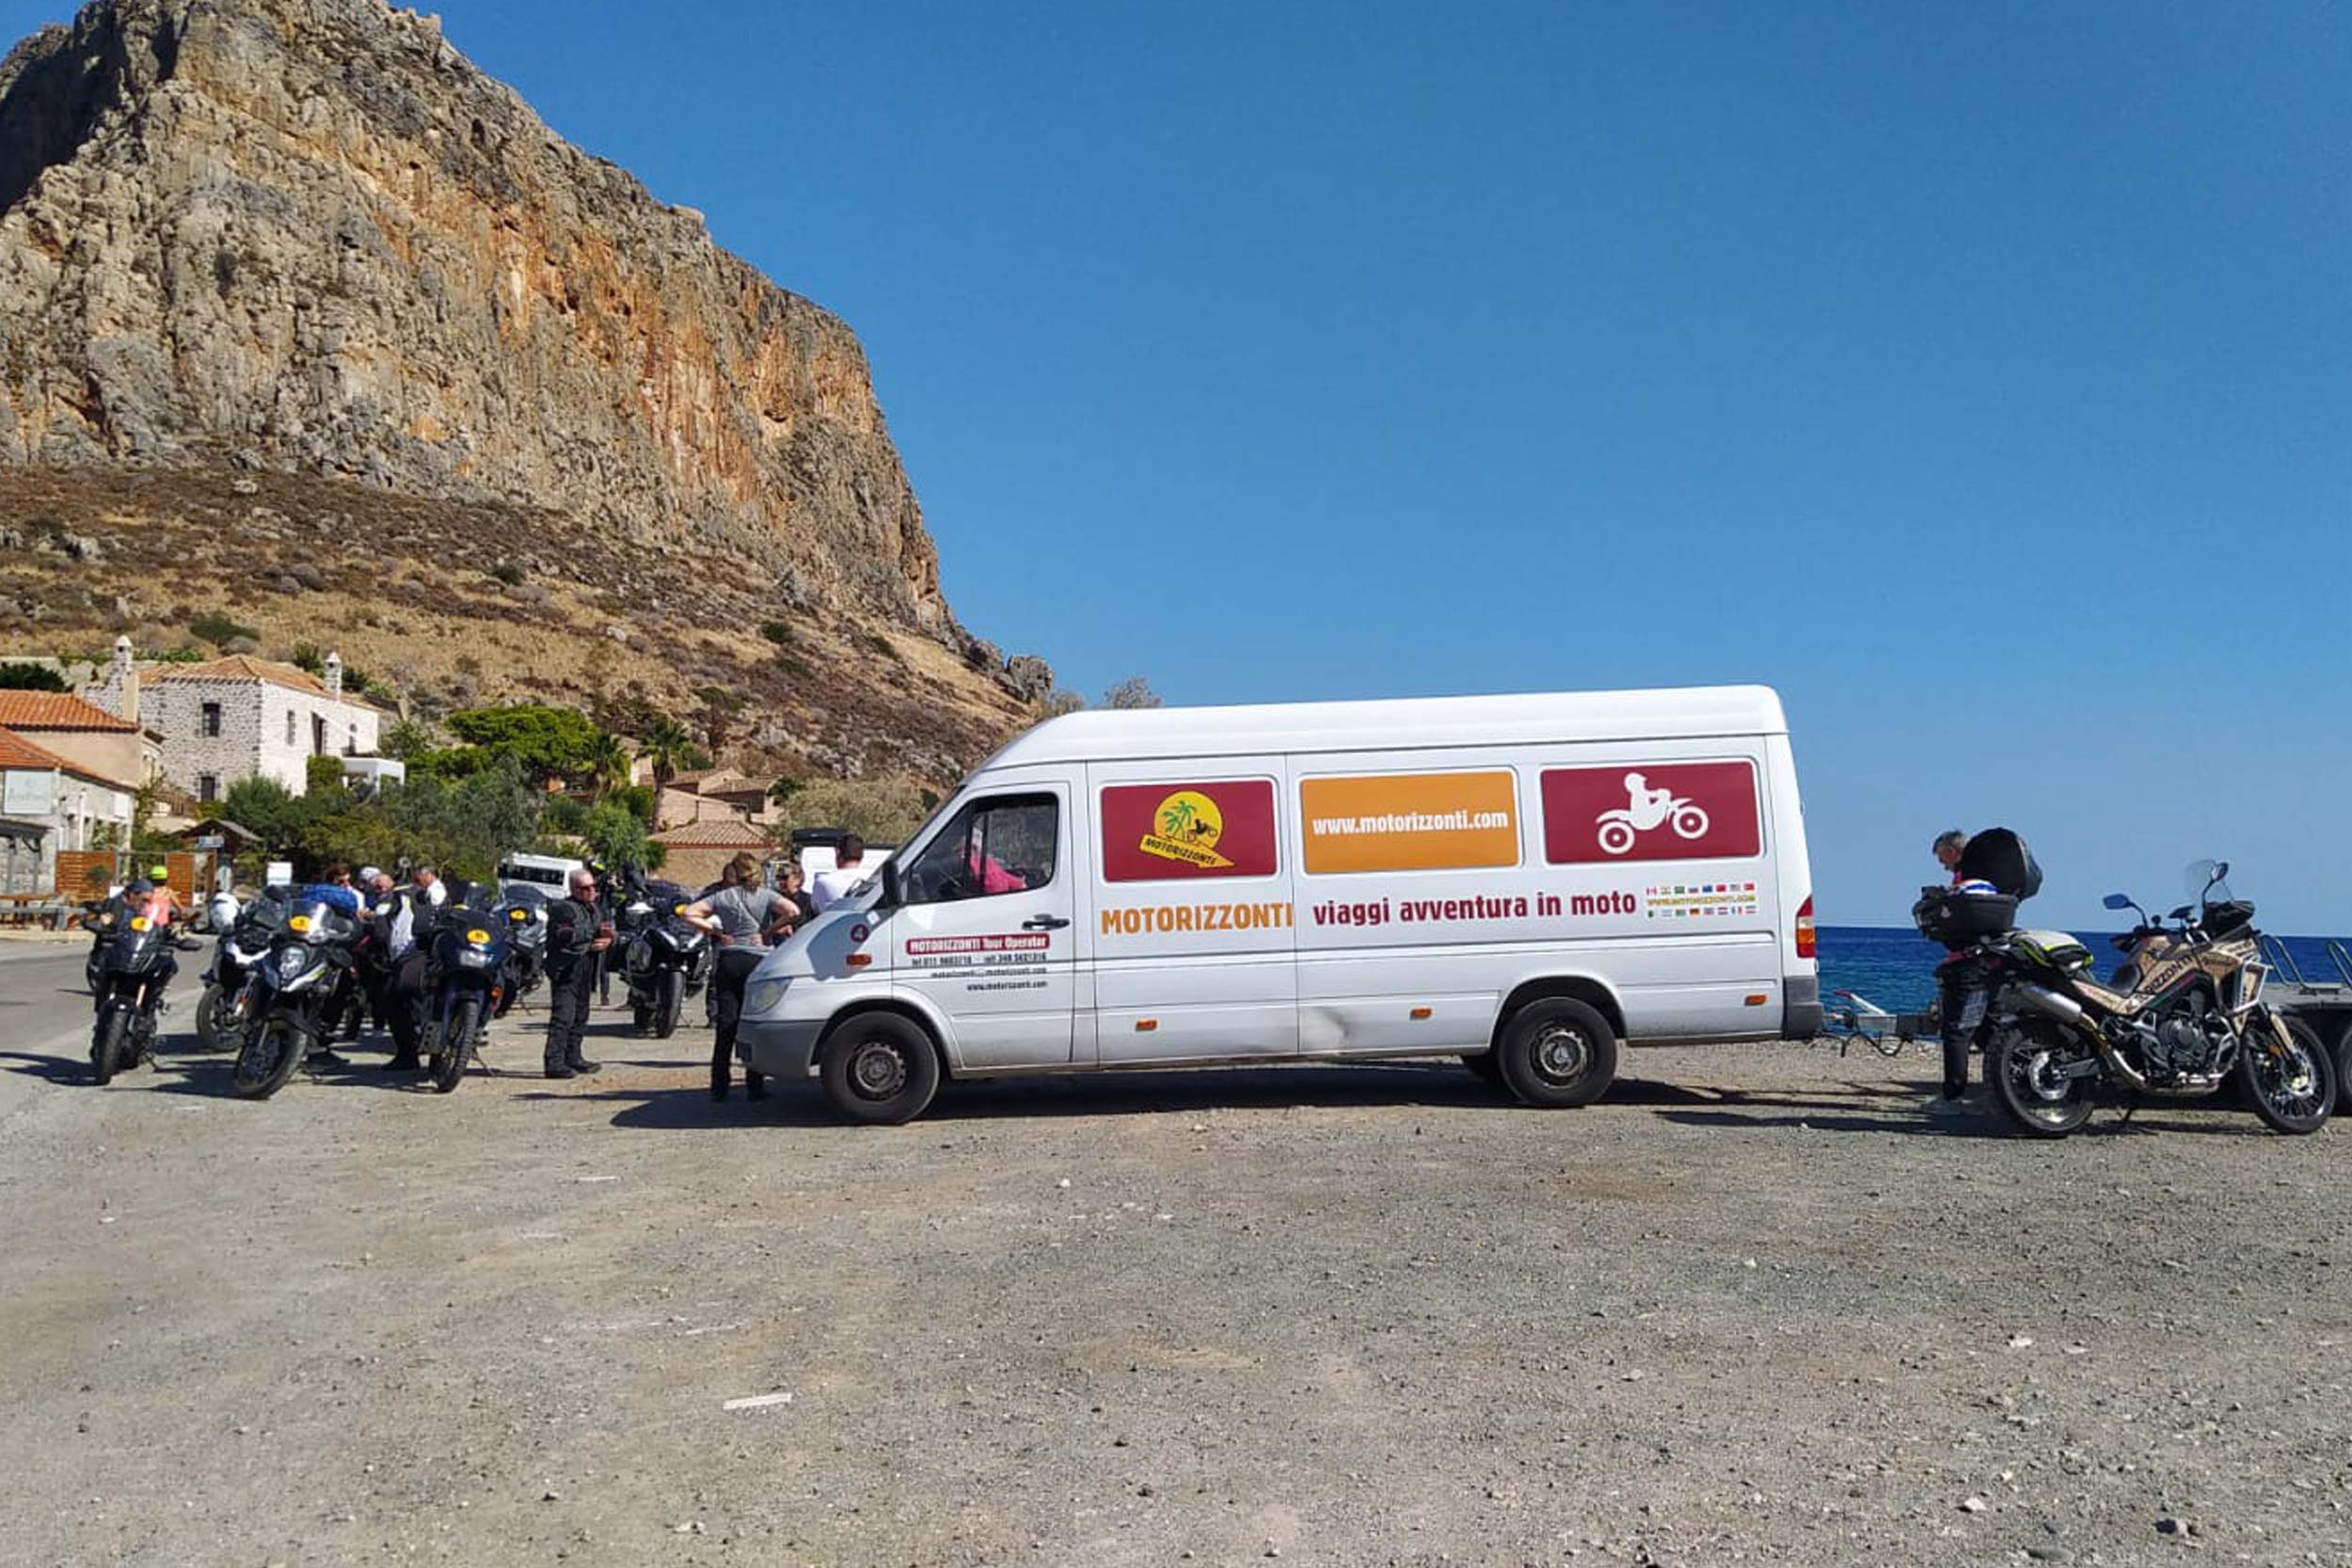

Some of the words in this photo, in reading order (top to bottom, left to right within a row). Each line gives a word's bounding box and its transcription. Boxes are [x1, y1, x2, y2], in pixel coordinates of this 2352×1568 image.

[1311, 810, 1509, 836] www.motorizzonti.com
[1145, 837, 1216, 865] MOTORIZZONTI
[1101, 902, 1294, 935] MOTORIZZONTI
[1312, 897, 1390, 926] viaggi
[1400, 895, 1528, 922] avventura
[1537, 892, 1561, 916] in
[1571, 891, 1637, 915] moto
[910, 937, 980, 953] MOTORIZZONTI
